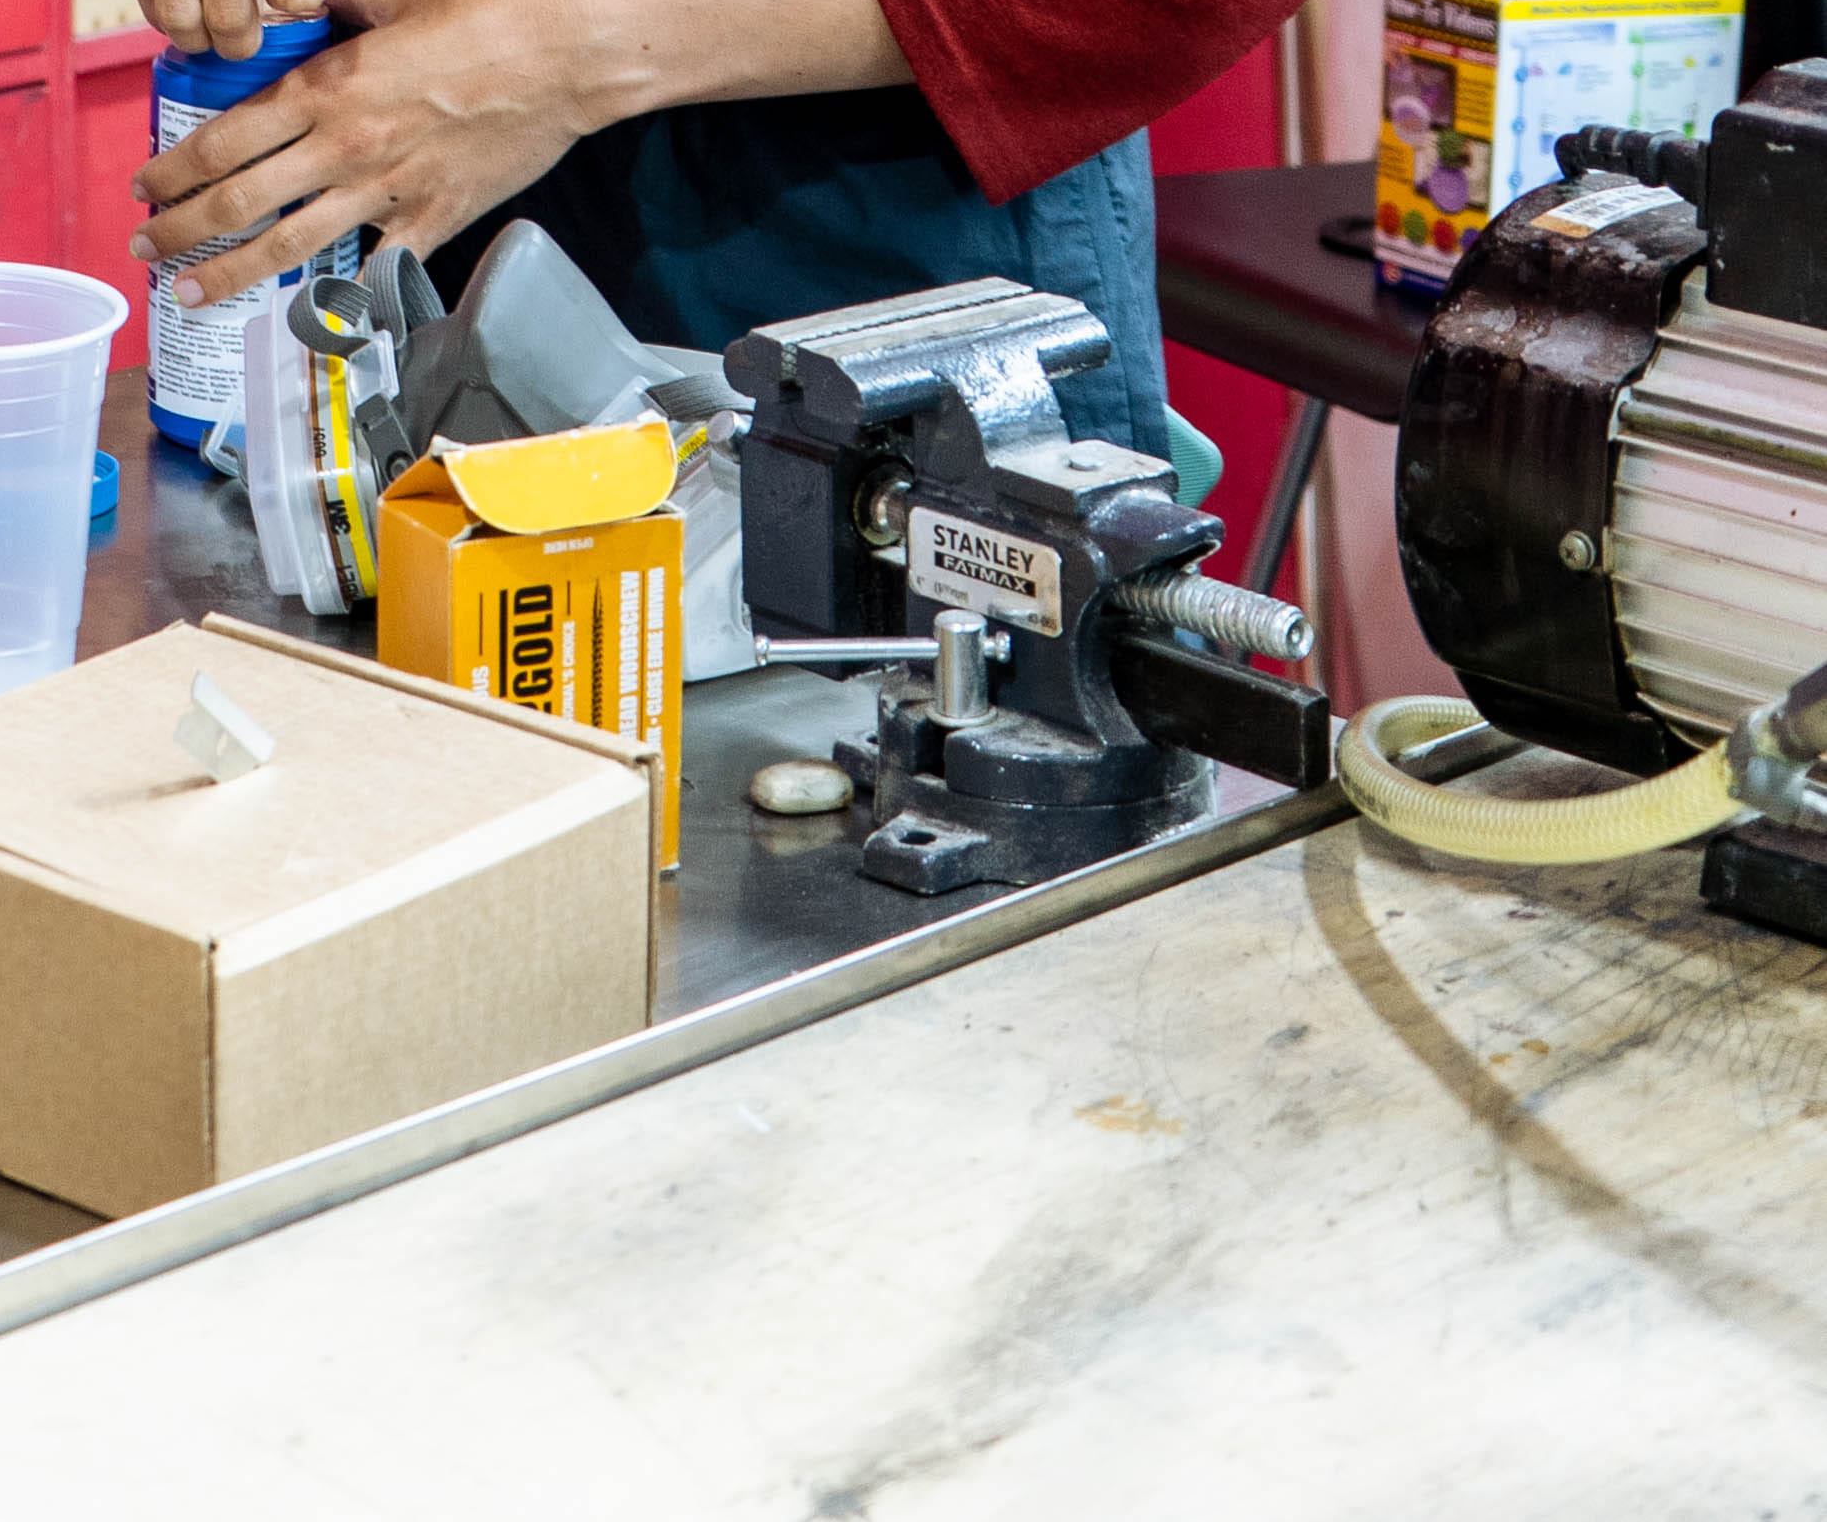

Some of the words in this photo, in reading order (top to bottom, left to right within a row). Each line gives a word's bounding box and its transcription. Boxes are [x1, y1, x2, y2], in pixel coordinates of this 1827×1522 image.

[328, 499, 351, 536] 3M
[933, 523, 1034, 574] STANLEY
[648, 566, 665, 629] DRIVING
[943, 554, 1027, 594] FATMAX
[619, 571, 640, 694] WOODSCREW
[647, 670, 664, 715] CLOSE
